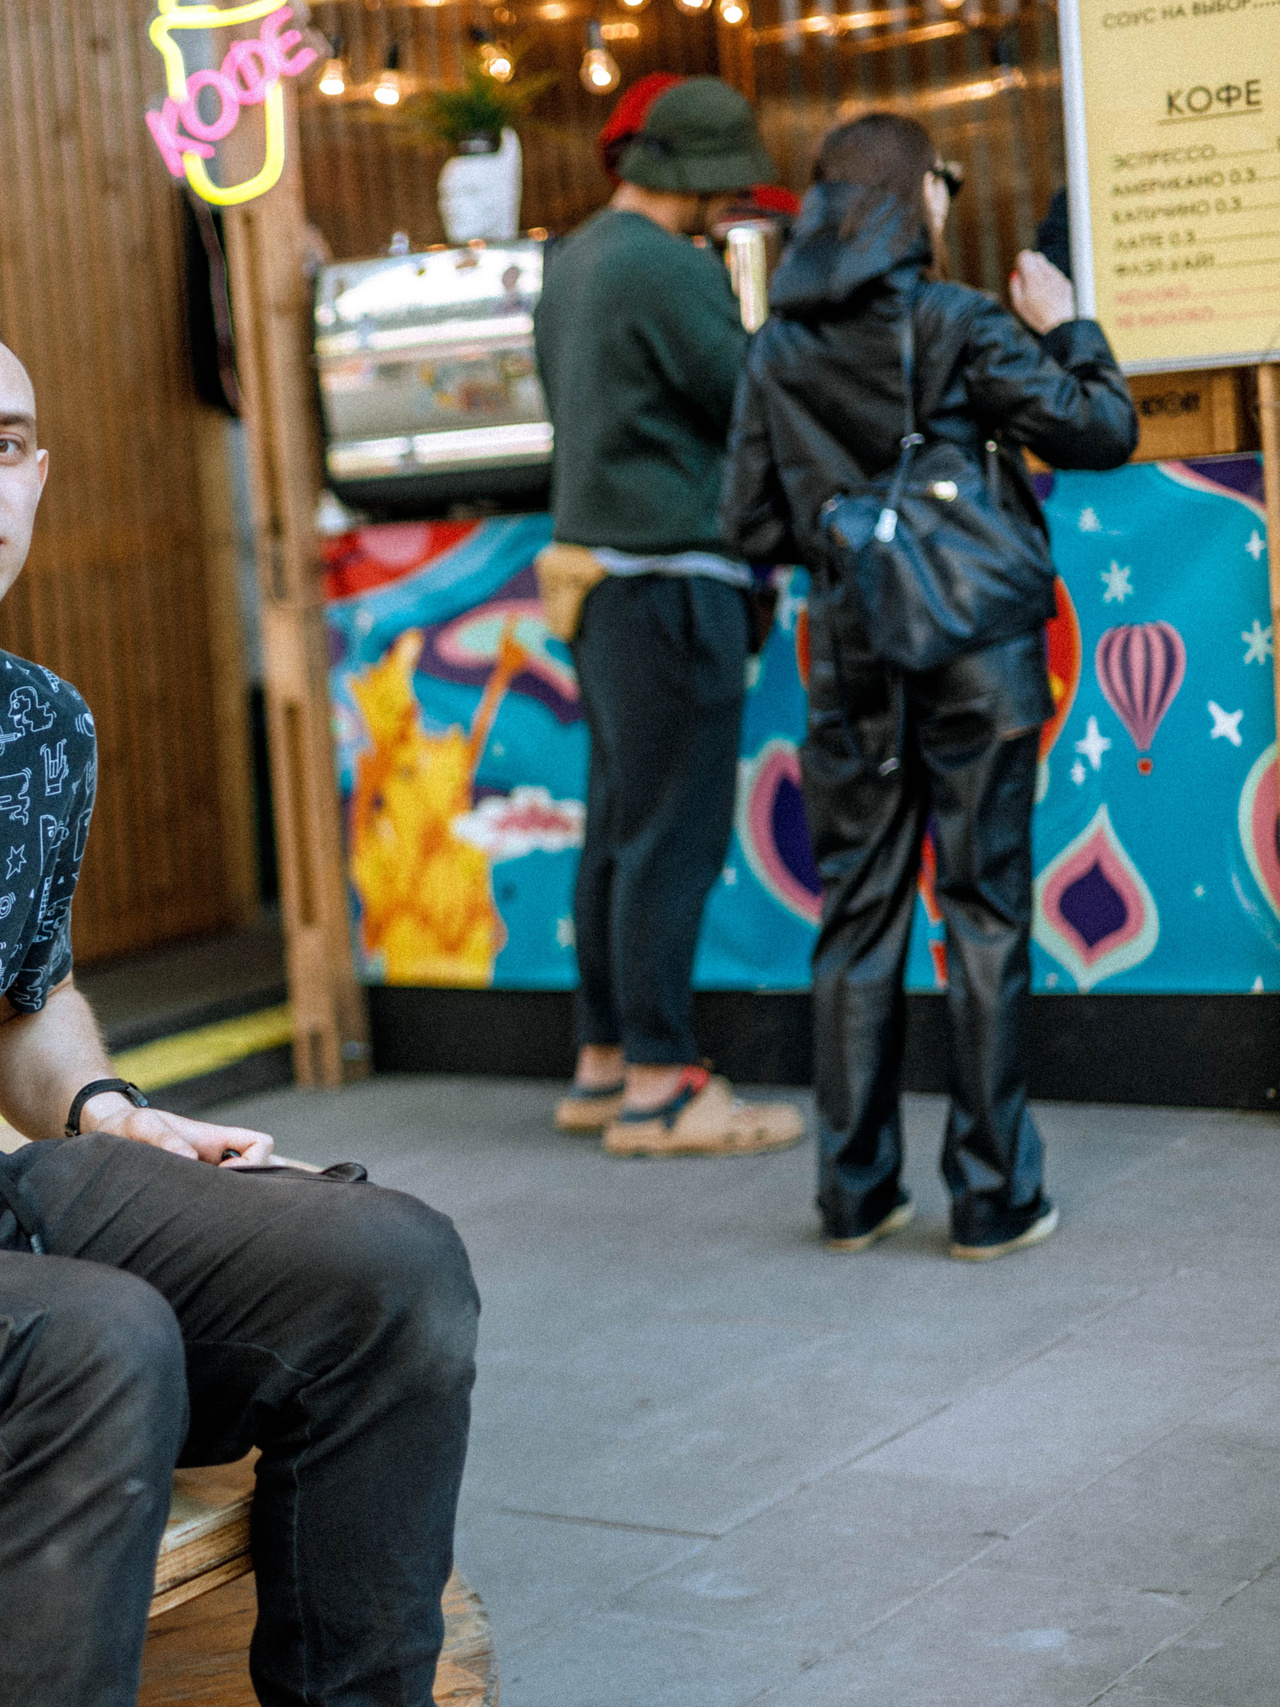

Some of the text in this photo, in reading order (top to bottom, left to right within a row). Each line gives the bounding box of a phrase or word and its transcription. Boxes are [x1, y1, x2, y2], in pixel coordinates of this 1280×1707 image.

[1102, 7, 1155, 30] СОУС
[1161, 4, 1187, 20] НА
[145, 6, 318, 177] КОФЕ
[1166, 79, 1261, 117] КОФЕ
[1114, 144, 1217, 172] ЭСПРЕССО
[1111, 170, 1225, 197] АМЕРИКАНО
[1114, 234, 1164, 252] ЛАТТЕ
